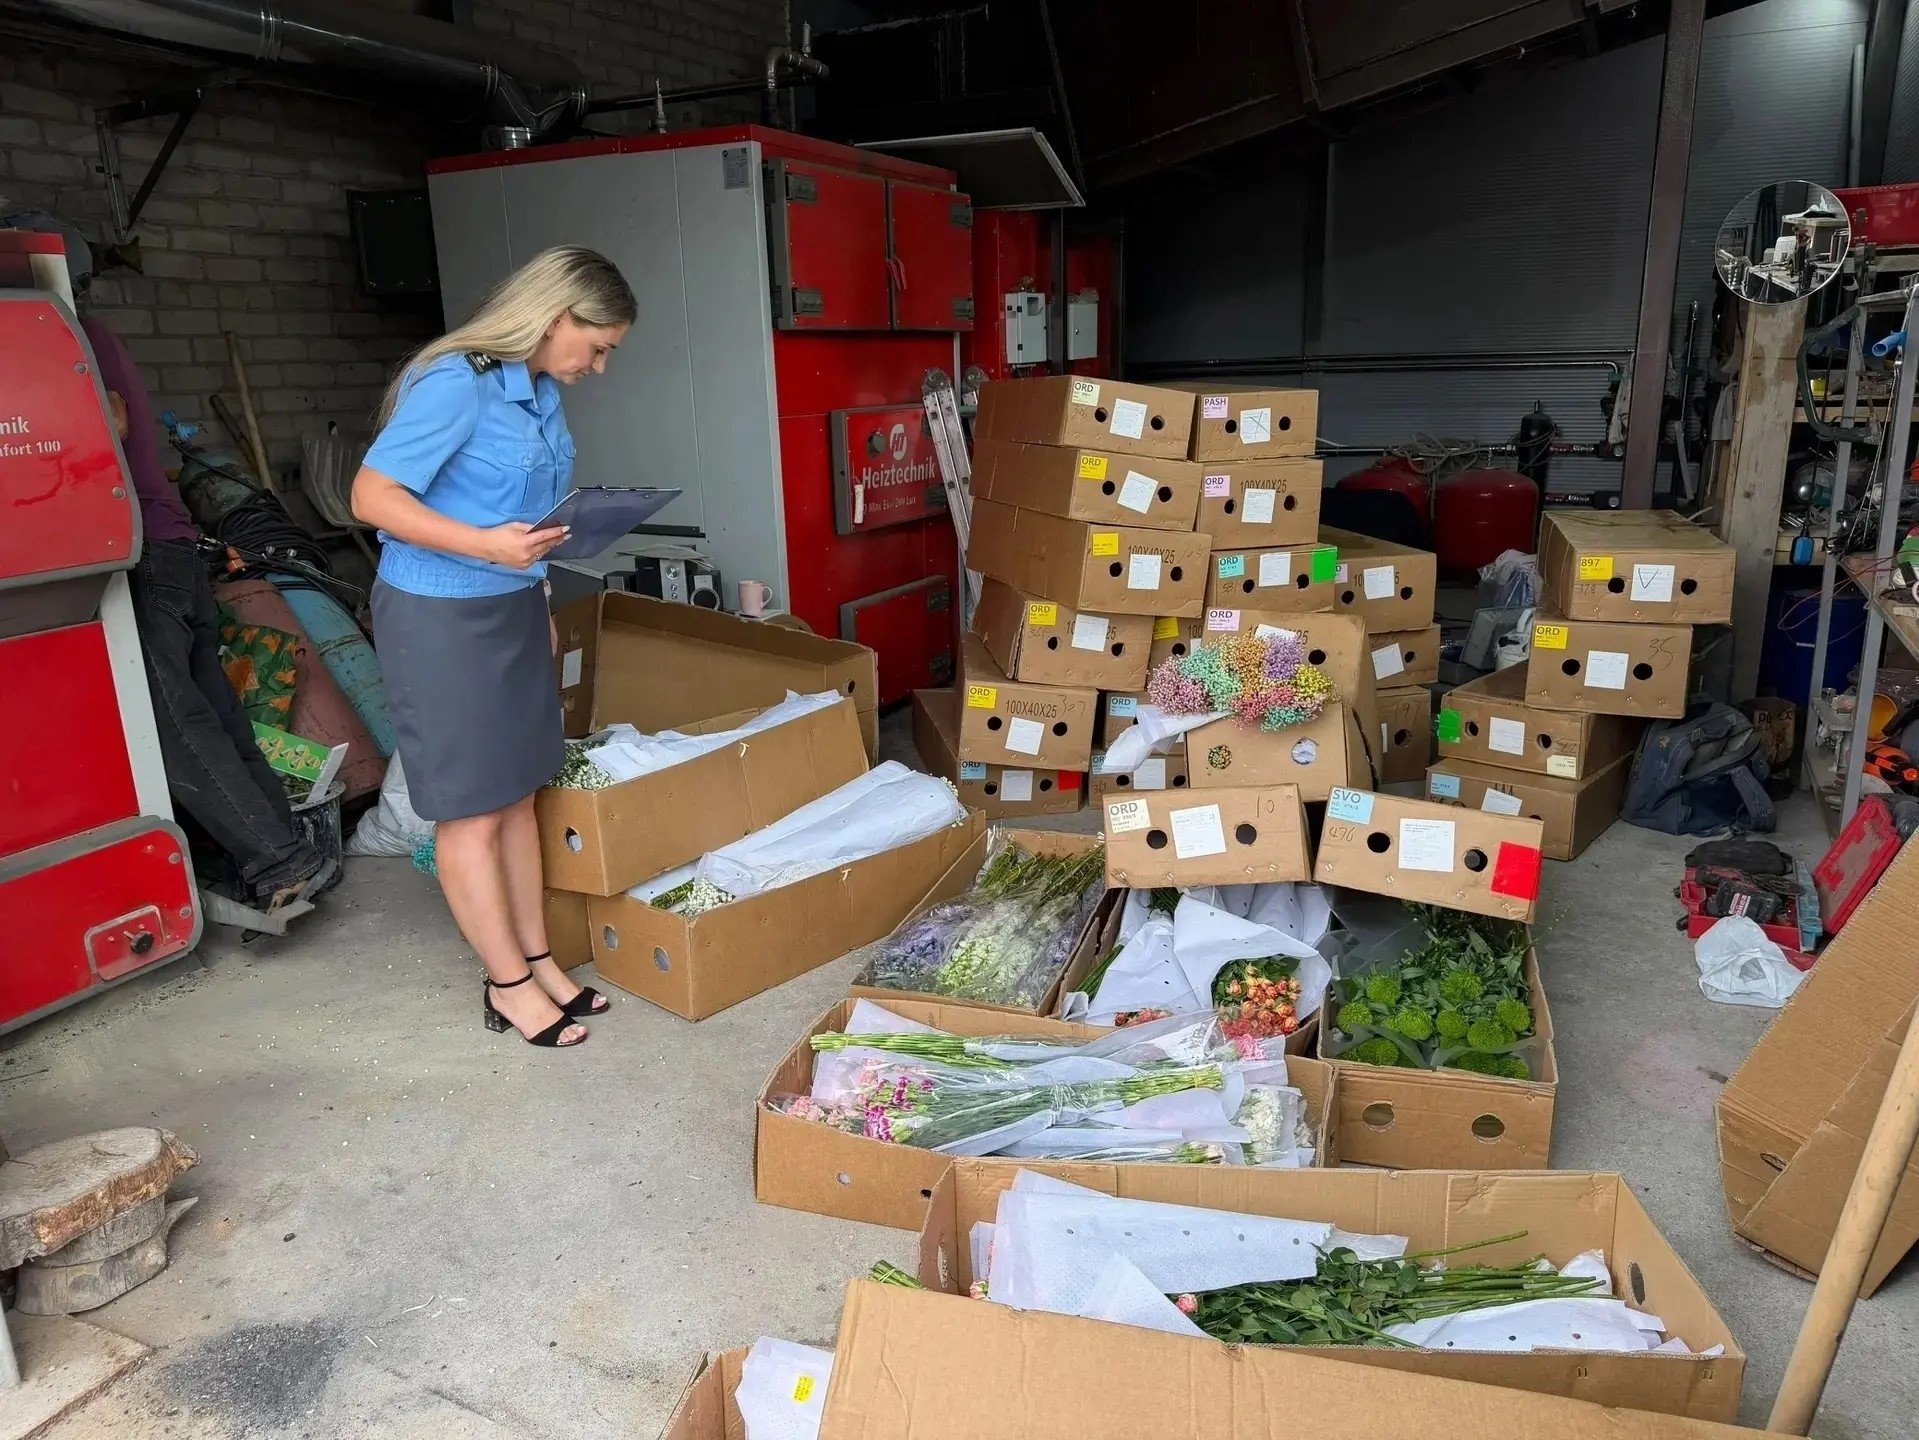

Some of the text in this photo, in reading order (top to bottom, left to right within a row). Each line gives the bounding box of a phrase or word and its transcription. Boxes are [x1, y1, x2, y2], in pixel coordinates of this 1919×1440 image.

[1074, 382, 1094, 393] ORD
[1204, 398, 1226, 406] PASH
[0, 416, 30, 435] nik
[36, 440, 61, 453] 100
[1081, 457, 1101, 466] ORD
[862, 456, 936, 489] Heiztechnik
[1205, 477, 1224, 486] ORD
[1219, 556, 1239, 566] ORD
[1580, 558, 1601, 567] 897
[1030, 604, 1051, 613] ORD
[1210, 610, 1233, 619] ORD
[1536, 626, 1560, 636] ORD
[969, 687, 990, 697] ORD
[1111, 697, 1131, 706] ORD
[1005, 699, 1058, 719] 100X40X25
[961, 760, 981, 768] ORD
[1092, 756, 1106, 764] OR
[1332, 789, 1362, 804] SVO
[1110, 802, 1138, 816] ORD
[1328, 826, 1355, 843] 476
